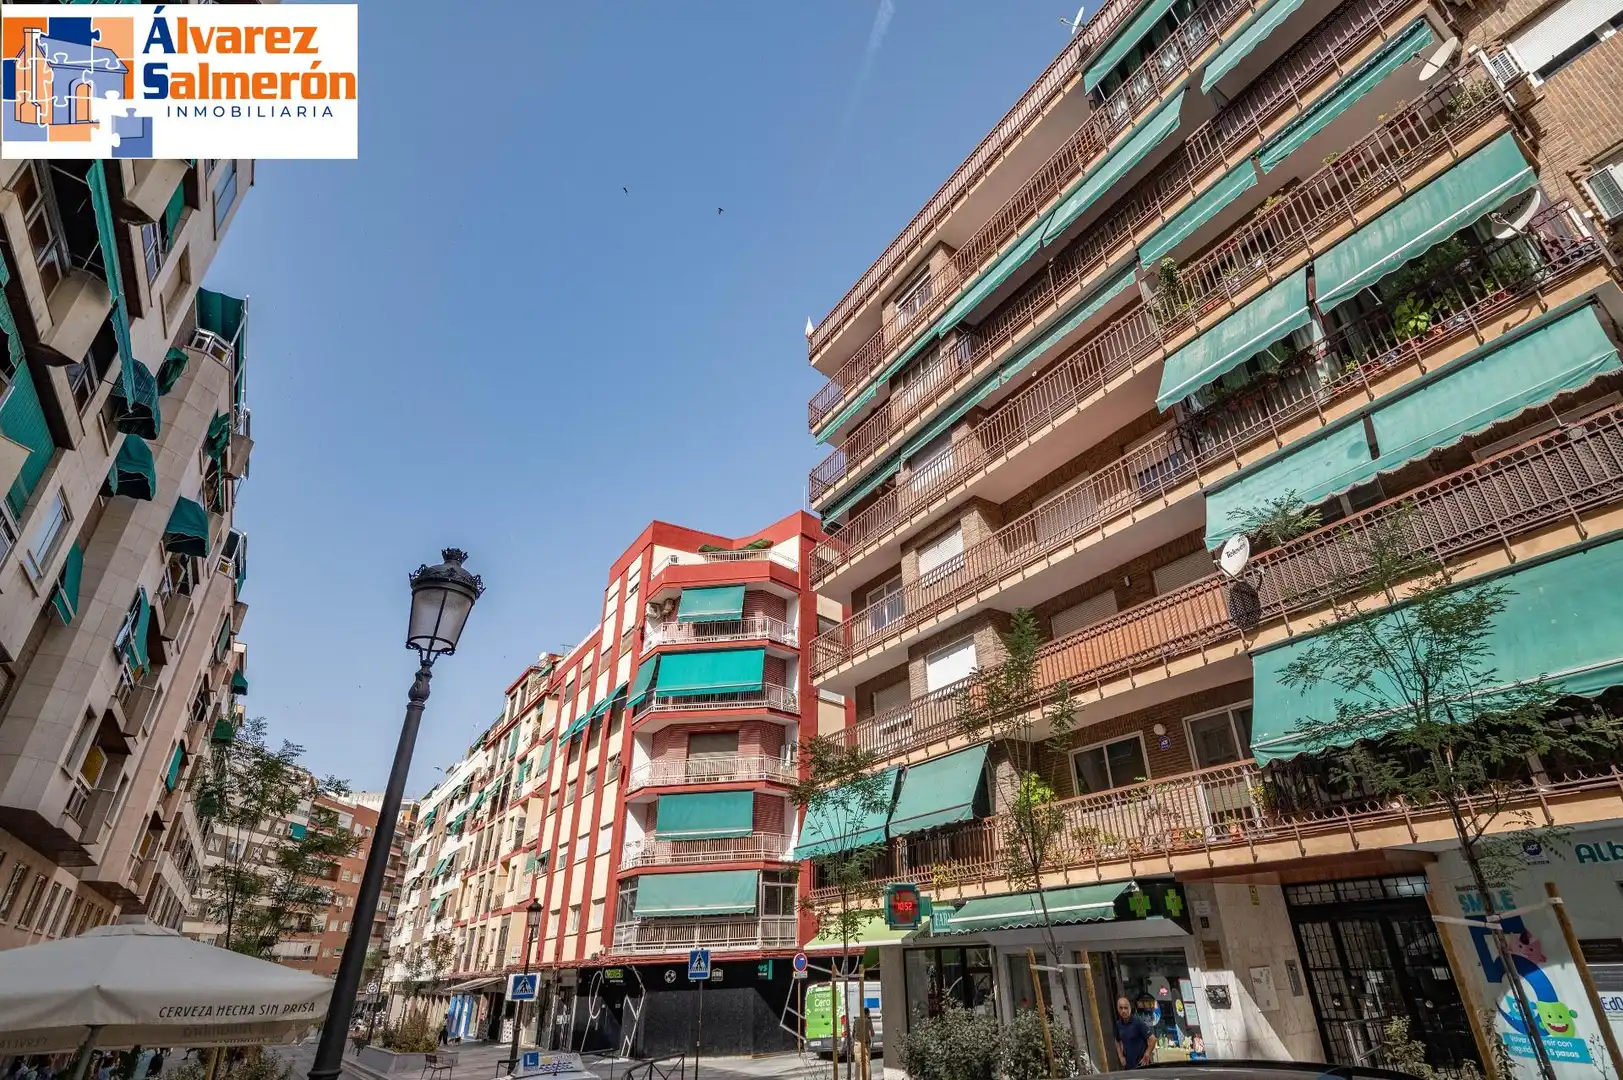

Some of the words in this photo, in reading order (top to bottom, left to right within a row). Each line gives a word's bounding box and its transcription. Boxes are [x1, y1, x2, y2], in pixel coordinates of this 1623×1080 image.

[1458, 890, 1516, 913] SMLE
[159, 1006, 212, 1018] CERVEZA
[216, 1004, 255, 1017] HECHA
[259, 1003, 279, 1015] SIN
[282, 1002, 315, 1014] PRISA
